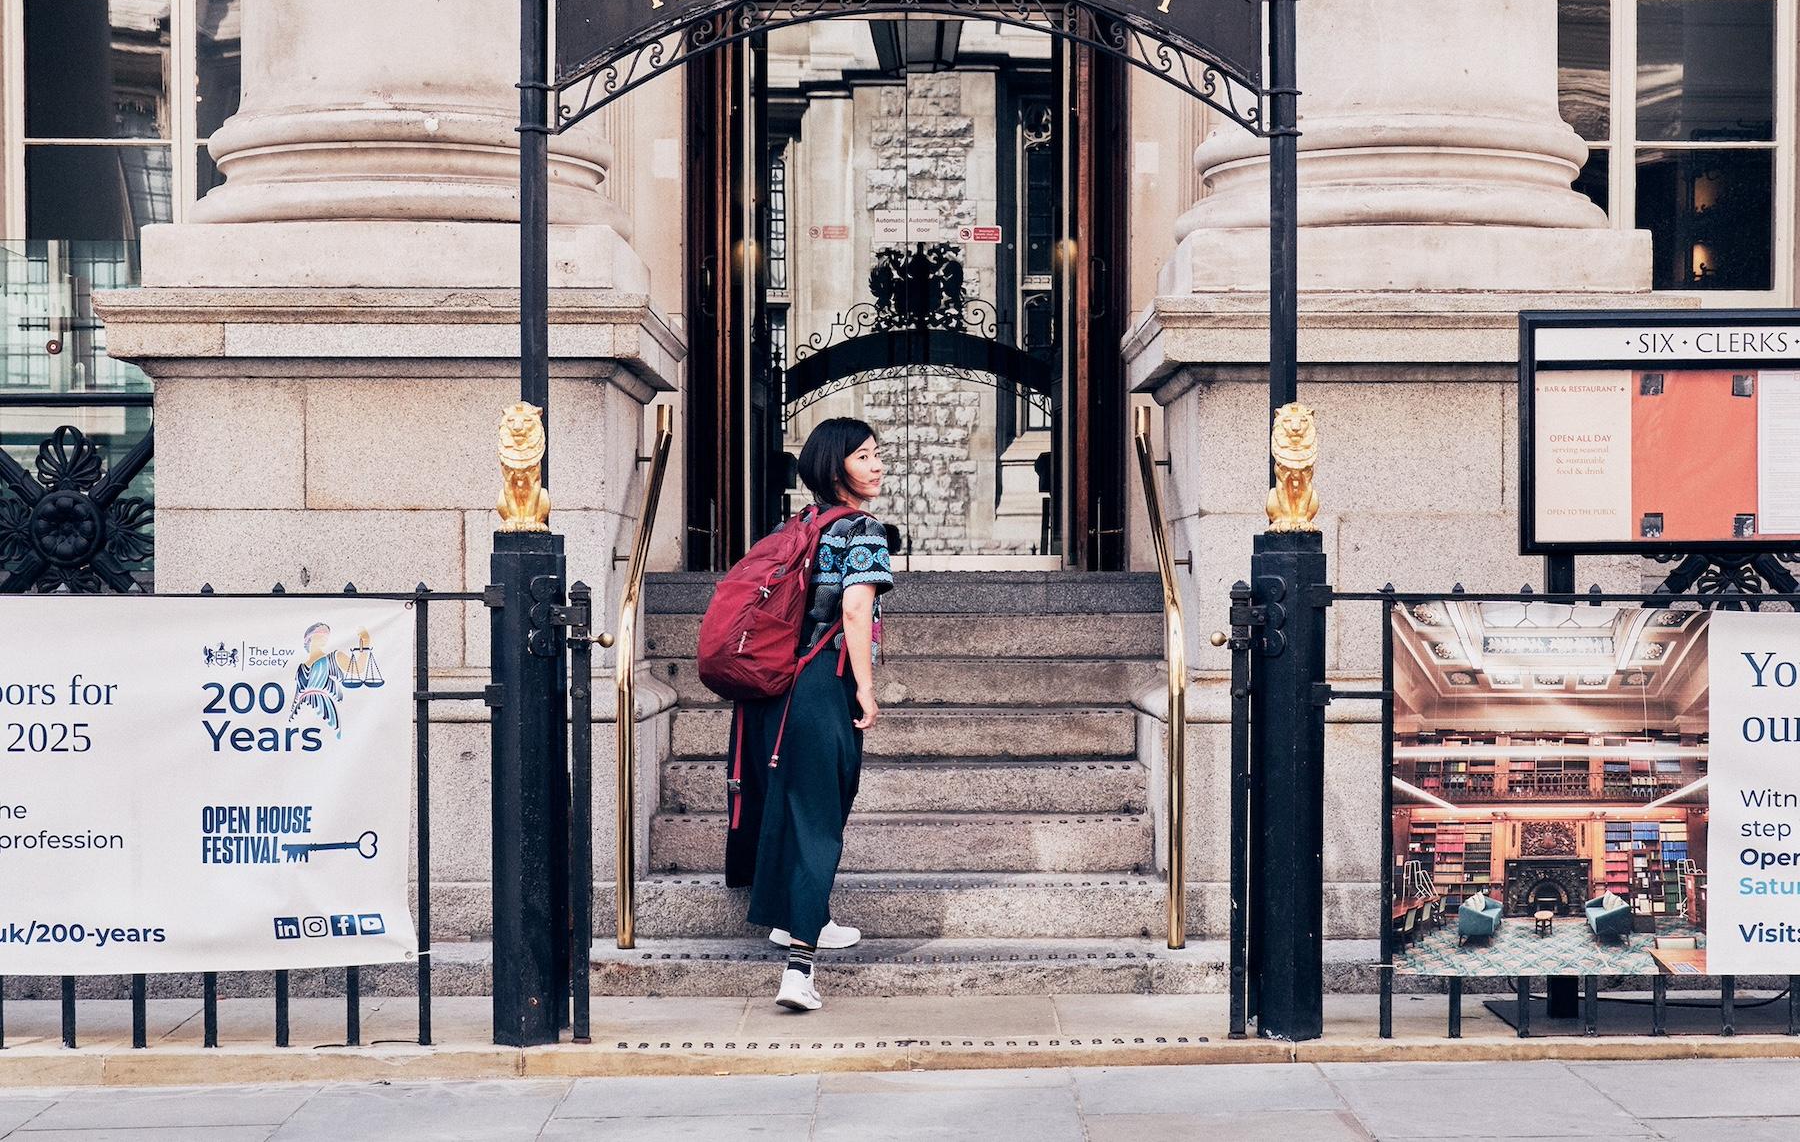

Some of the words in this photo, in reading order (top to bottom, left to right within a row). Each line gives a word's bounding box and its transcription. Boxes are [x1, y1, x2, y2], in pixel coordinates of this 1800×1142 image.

[1638, 332, 1675, 354] SIX
[1695, 332, 1788, 354] CLERKS
[1544, 385, 1559, 393] BAR
[1560, 385, 1567, 393] &
[1568, 385, 1618, 393] RESTAURANT
[1549, 434, 1575, 443] OPEN
[1577, 434, 1592, 443] ALL
[1594, 434, 1613, 443] DAY
[1555, 456, 1564, 464] &
[1556, 467, 1573, 475] food
[1574, 467, 1583, 475] &
[248, 646, 269, 657] The
[271, 646, 296, 656] Law
[248, 656, 290, 669] Society
[1740, 651, 1800, 688] Yo
[0, 683, 56, 706] ors
[68, 673, 118, 706] for
[201, 681, 286, 715] 200
[6, 723, 92, 753] 2025
[201, 720, 323, 753] Years
[202, 805, 251, 835] OPEN
[256, 805, 313, 834] HOUSE
[1740, 820, 1792, 842] step
[0, 829, 124, 854] profession
[202, 835, 280, 865] FESTIVAL
[1739, 876, 1800, 896] Satu
[1738, 921, 1800, 943] Visit:
